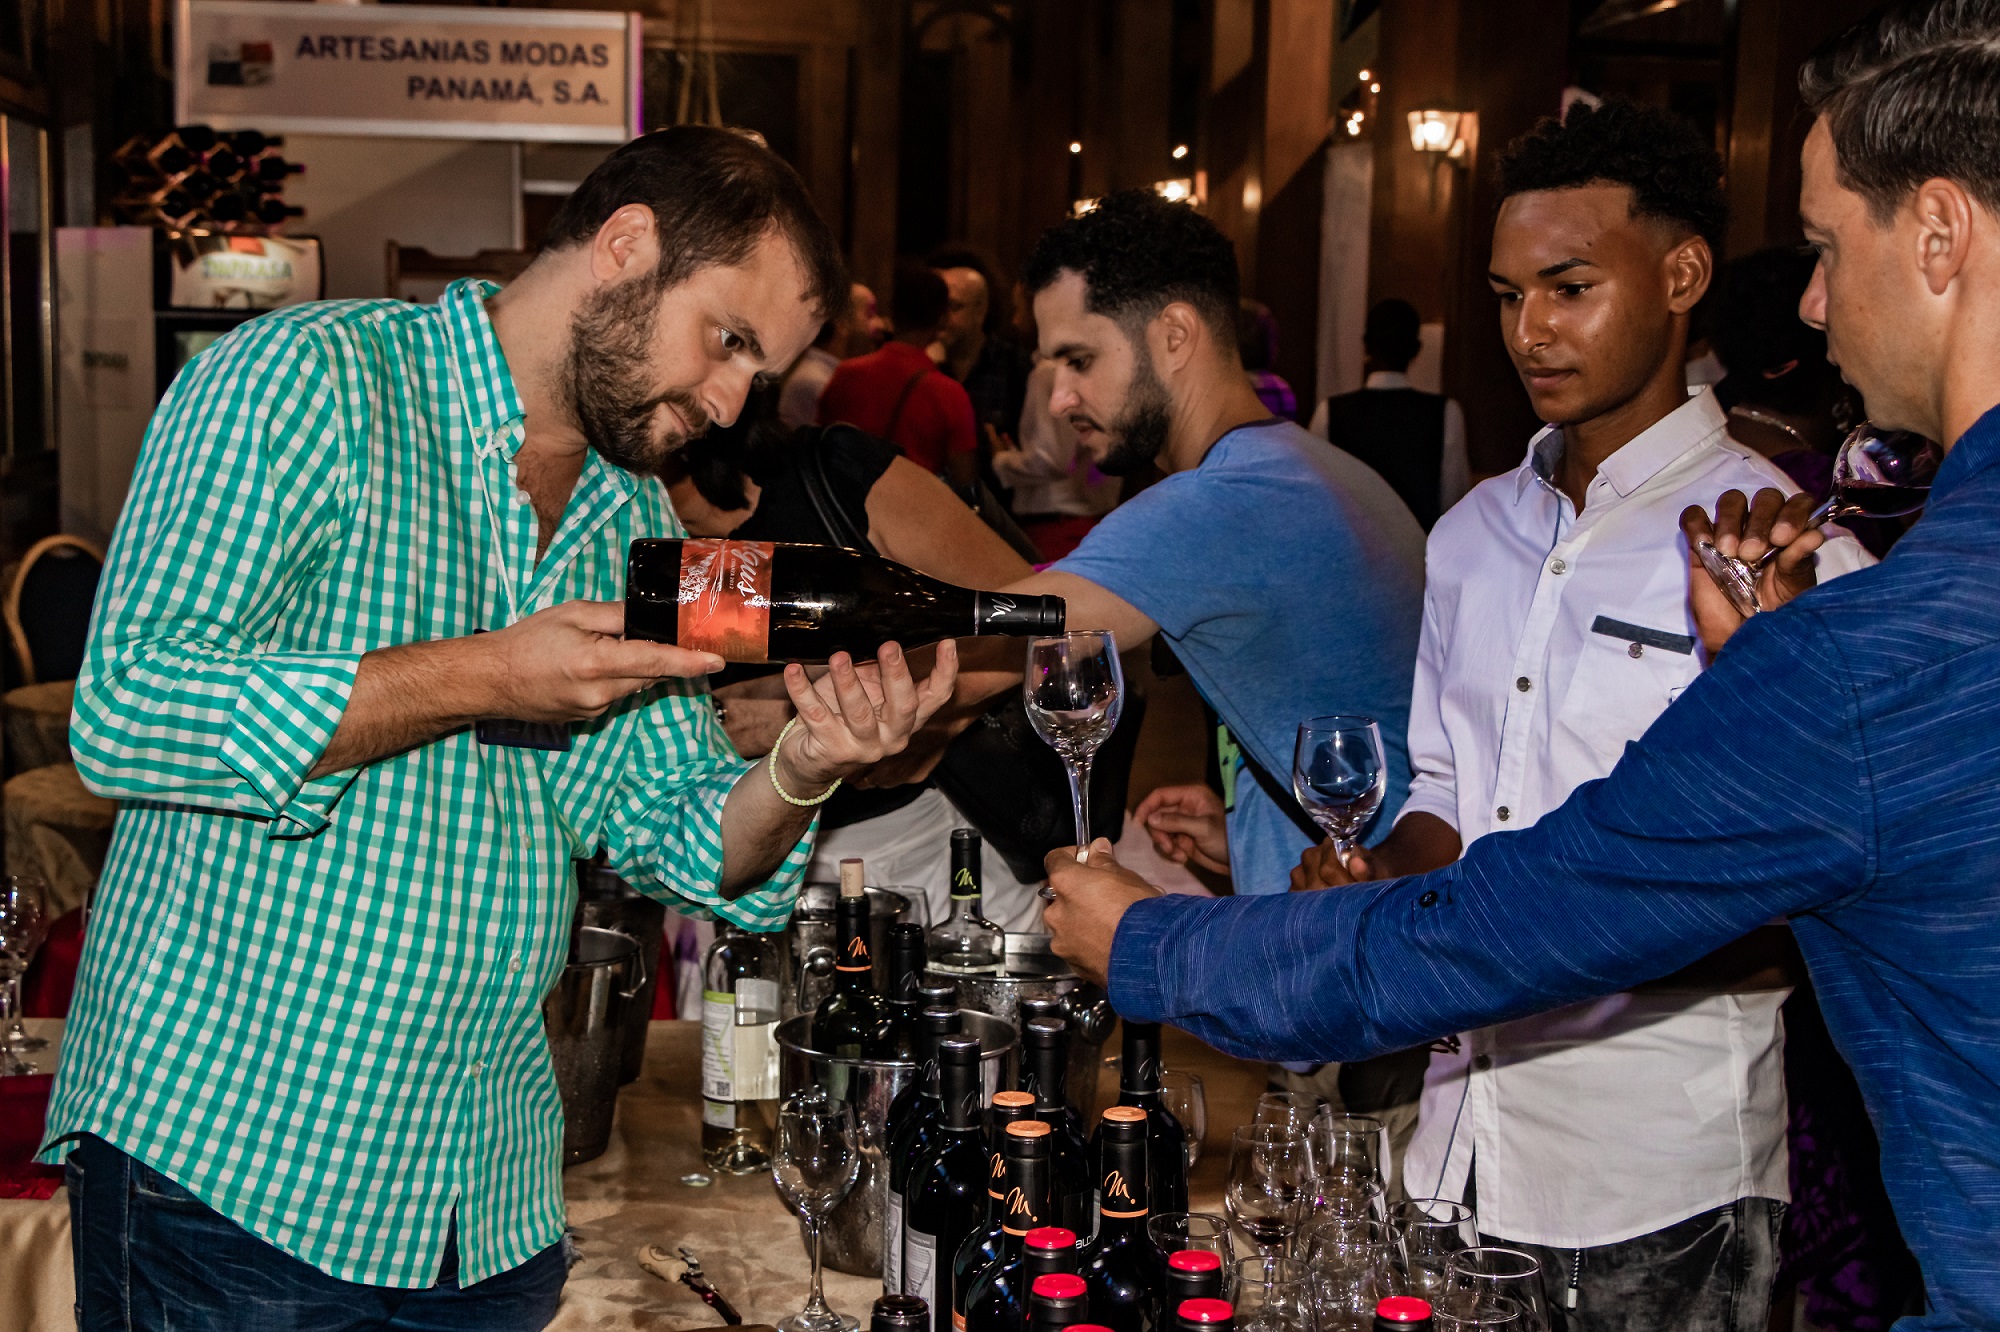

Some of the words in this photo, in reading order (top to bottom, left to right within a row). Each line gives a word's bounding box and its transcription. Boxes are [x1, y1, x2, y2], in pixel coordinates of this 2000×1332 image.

[296, 34, 490, 63] ARTESANIAS
[501, 40, 608, 67] MODAS
[407, 73, 543, 106] PANAMÁ,
[553, 80, 608, 105] S.A.
